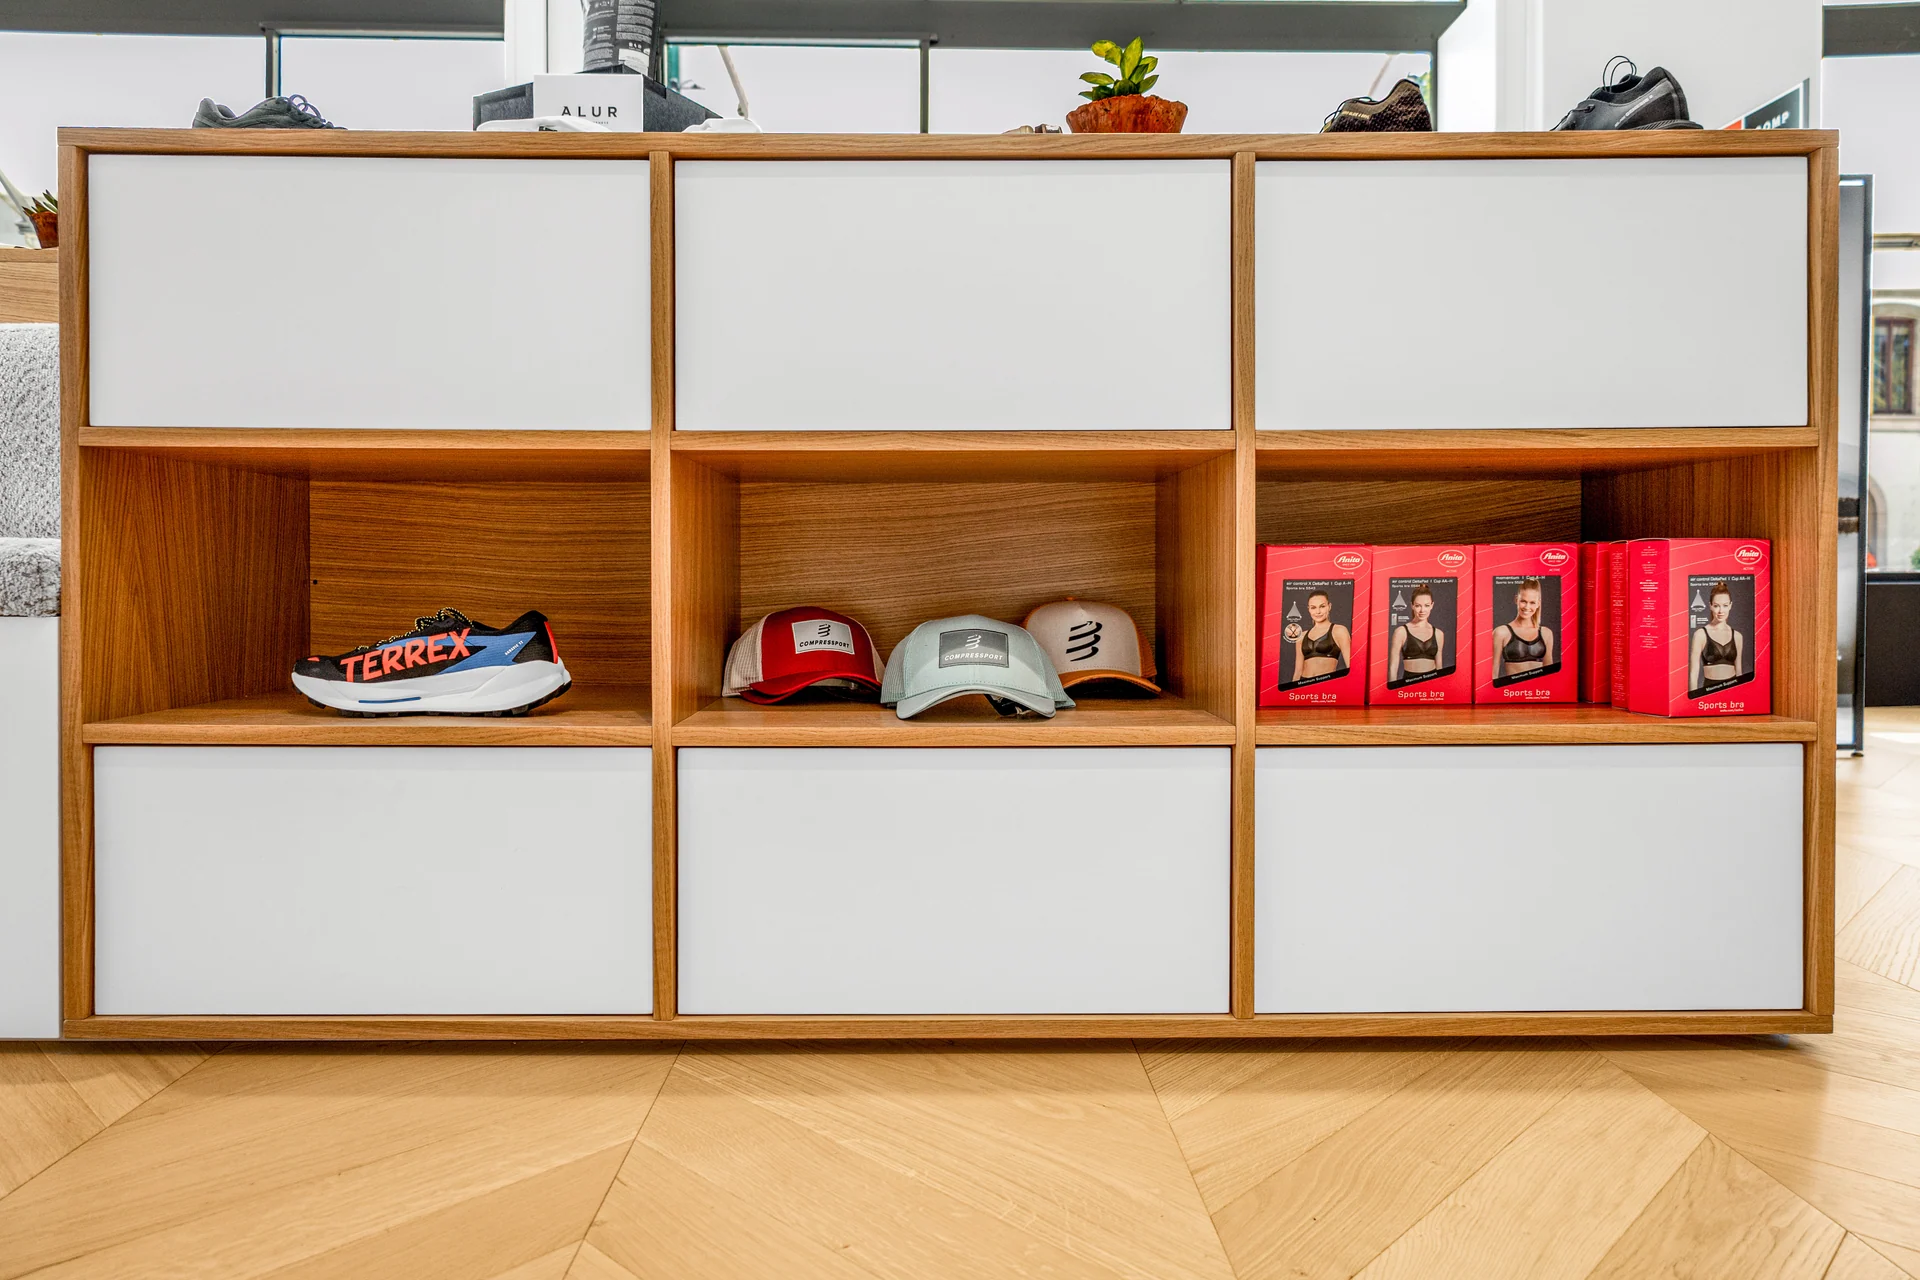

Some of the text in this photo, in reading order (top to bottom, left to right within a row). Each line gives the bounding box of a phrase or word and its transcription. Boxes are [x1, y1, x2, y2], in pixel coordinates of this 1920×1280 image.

[562, 106, 618, 118] ALUR
[1737, 550, 1759, 558] Anita
[800, 640, 850, 648] COMPRESSPORT
[340, 628, 470, 682] TERREX
[1289, 693, 1318, 701] Sports
[1398, 691, 1427, 699] Sports
[1504, 689, 1532, 697] Sports
[1698, 702, 1727, 711] Sports
